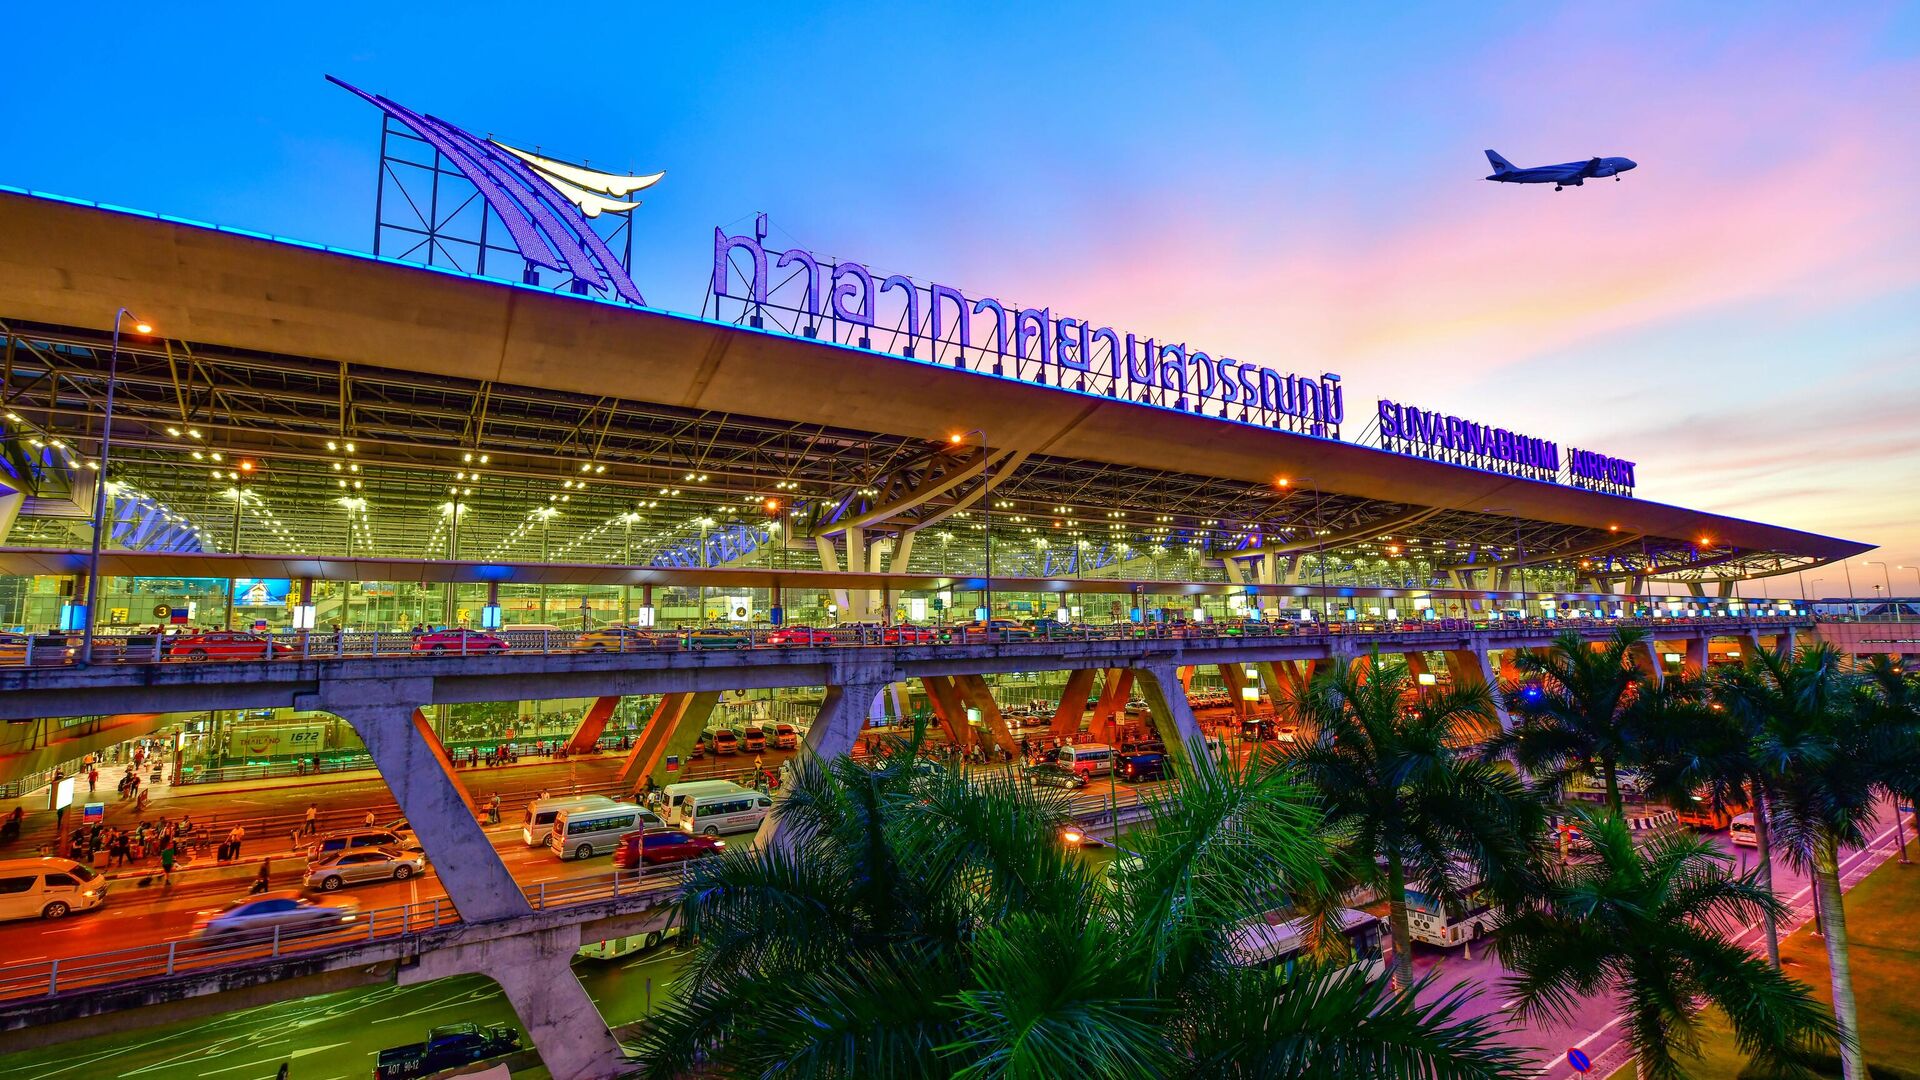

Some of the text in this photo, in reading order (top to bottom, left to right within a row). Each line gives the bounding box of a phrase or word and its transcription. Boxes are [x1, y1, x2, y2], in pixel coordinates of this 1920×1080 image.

[714, 213, 1344, 435] ท่าอากาศยานสุวรรณภูมิ
[1378, 400, 1637, 488] SUVARNABHUMI AIRPORT
[158, 607, 167, 616] 3
[240, 736, 280, 745] THAILAND
[290, 732, 319, 741] 1672
[388, 1064, 400, 1075] AOT
